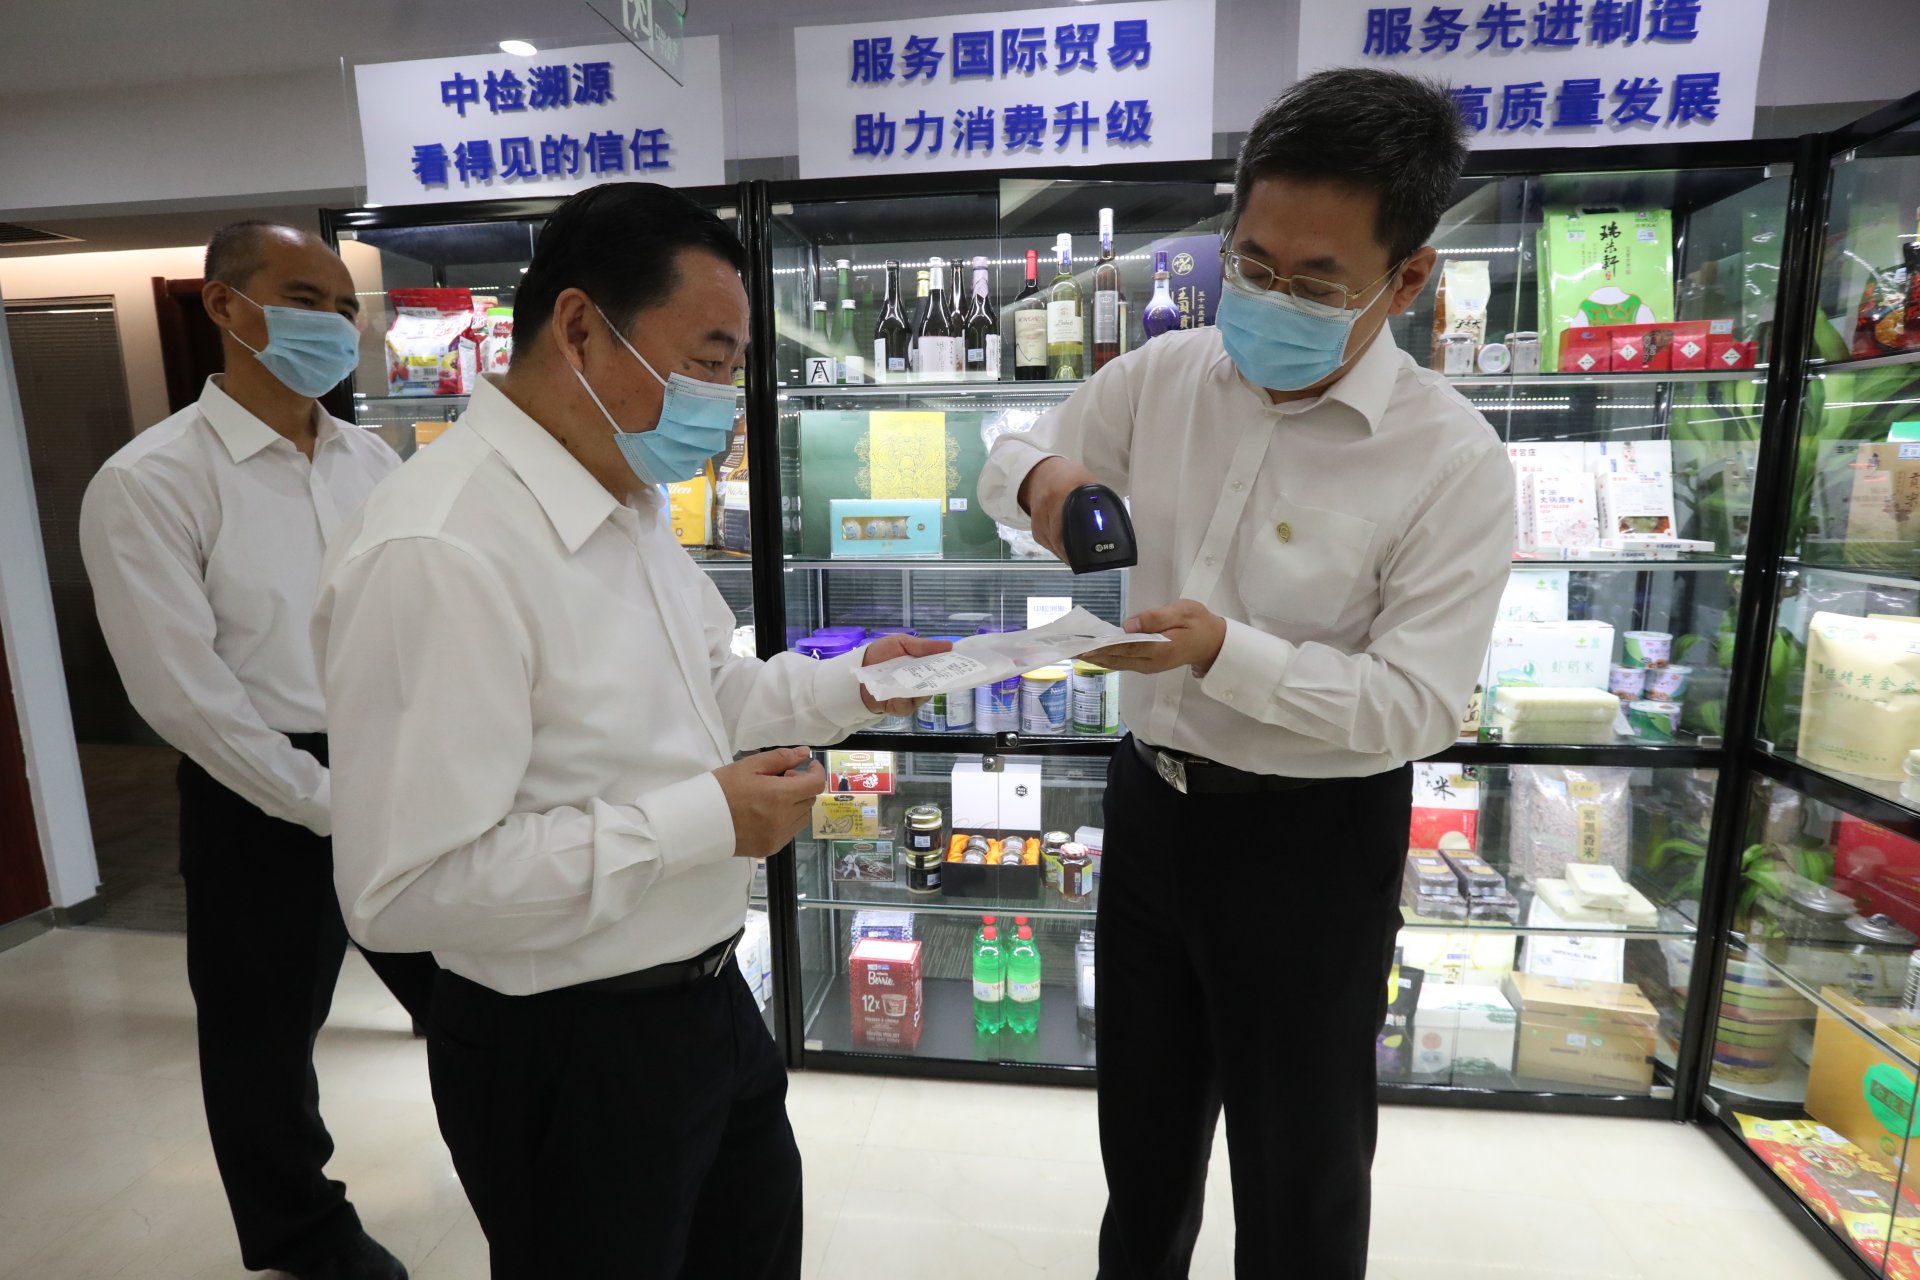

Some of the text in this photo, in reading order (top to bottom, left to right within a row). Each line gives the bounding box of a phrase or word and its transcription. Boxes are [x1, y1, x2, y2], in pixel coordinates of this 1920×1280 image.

[852, 18, 1153, 83] 服务国际贸易
[1363, 0, 1701, 55] 服务先进制造
[439, 62, 614, 116] 中检溯源
[853, 98, 1154, 157] 助力消费升级
[410, 128, 671, 186] 看得见的信任
